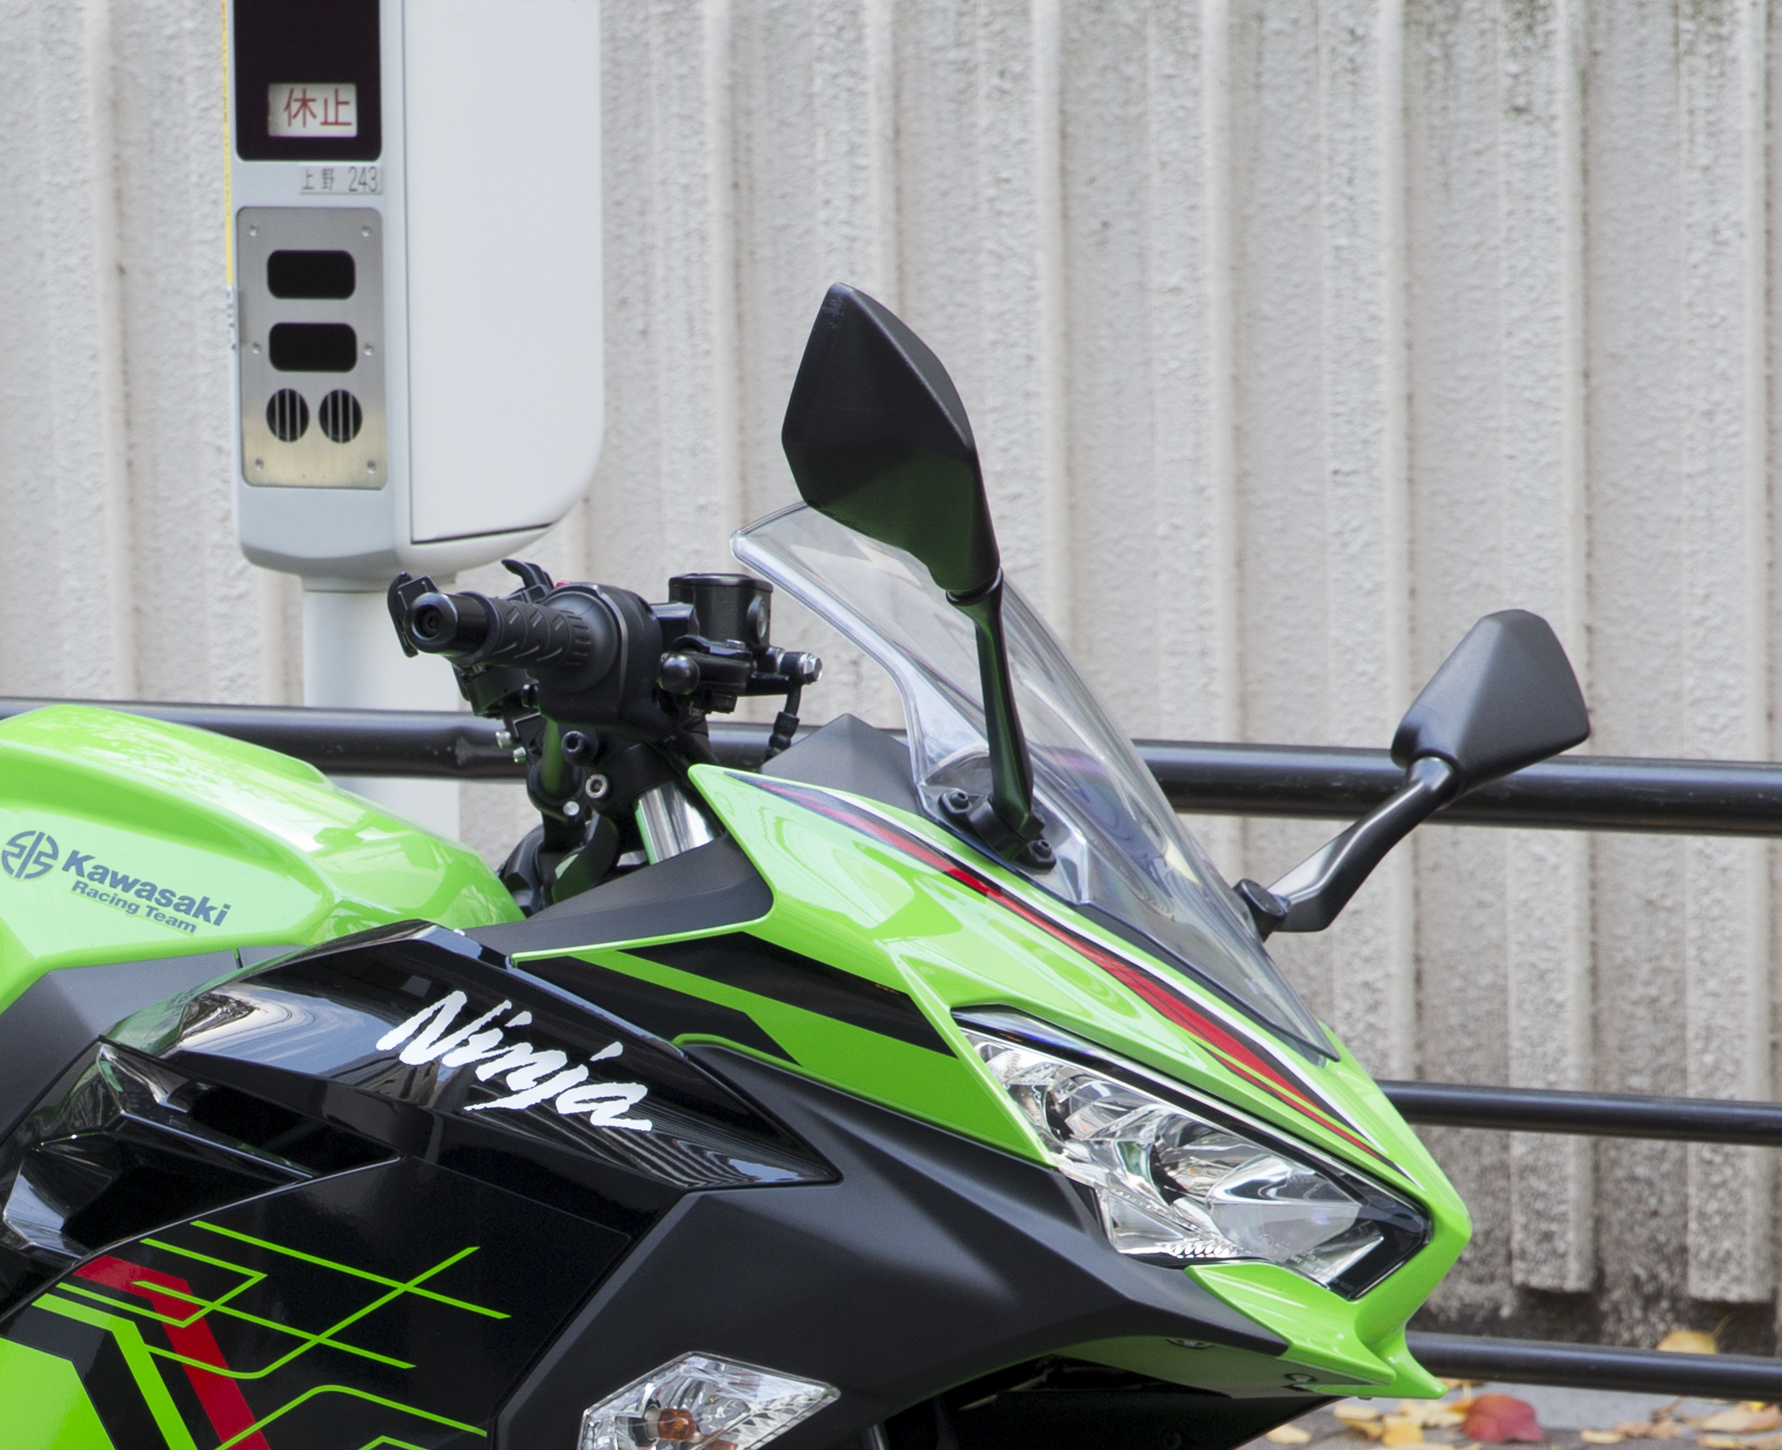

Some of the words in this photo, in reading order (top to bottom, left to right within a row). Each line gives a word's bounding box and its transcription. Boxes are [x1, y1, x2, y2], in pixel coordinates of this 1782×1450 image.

[283, 87, 353, 129] 休止
[302, 168, 335, 190] 上野
[348, 166, 378, 192] 243
[62, 849, 232, 927] Kawasaki
[71, 879, 140, 916] Racing
[144, 905, 197, 934] Team
[375, 990, 653, 1131] Ninja
